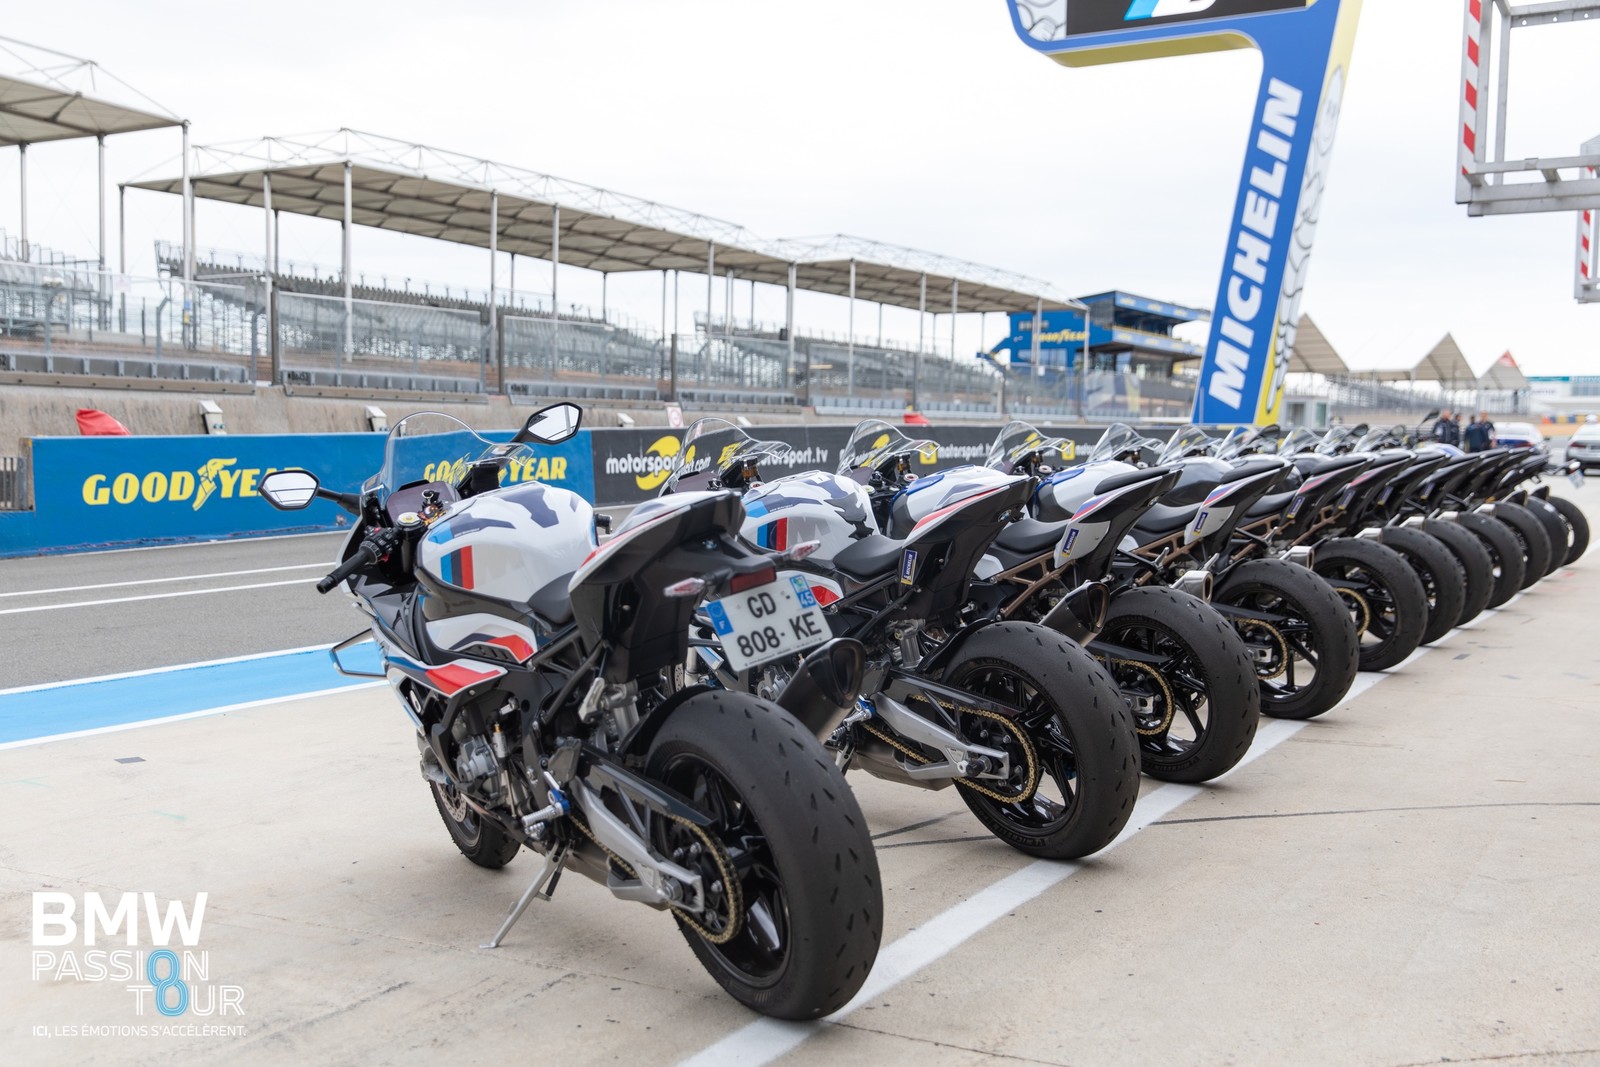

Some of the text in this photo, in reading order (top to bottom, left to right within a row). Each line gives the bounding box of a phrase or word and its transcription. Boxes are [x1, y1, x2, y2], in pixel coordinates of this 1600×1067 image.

[1208, 77, 1303, 410] MICHELIN
[747, 592, 776, 619] GD
[799, 590, 815, 607] 45
[718, 620, 726, 630] F
[789, 611, 822, 640] KE
